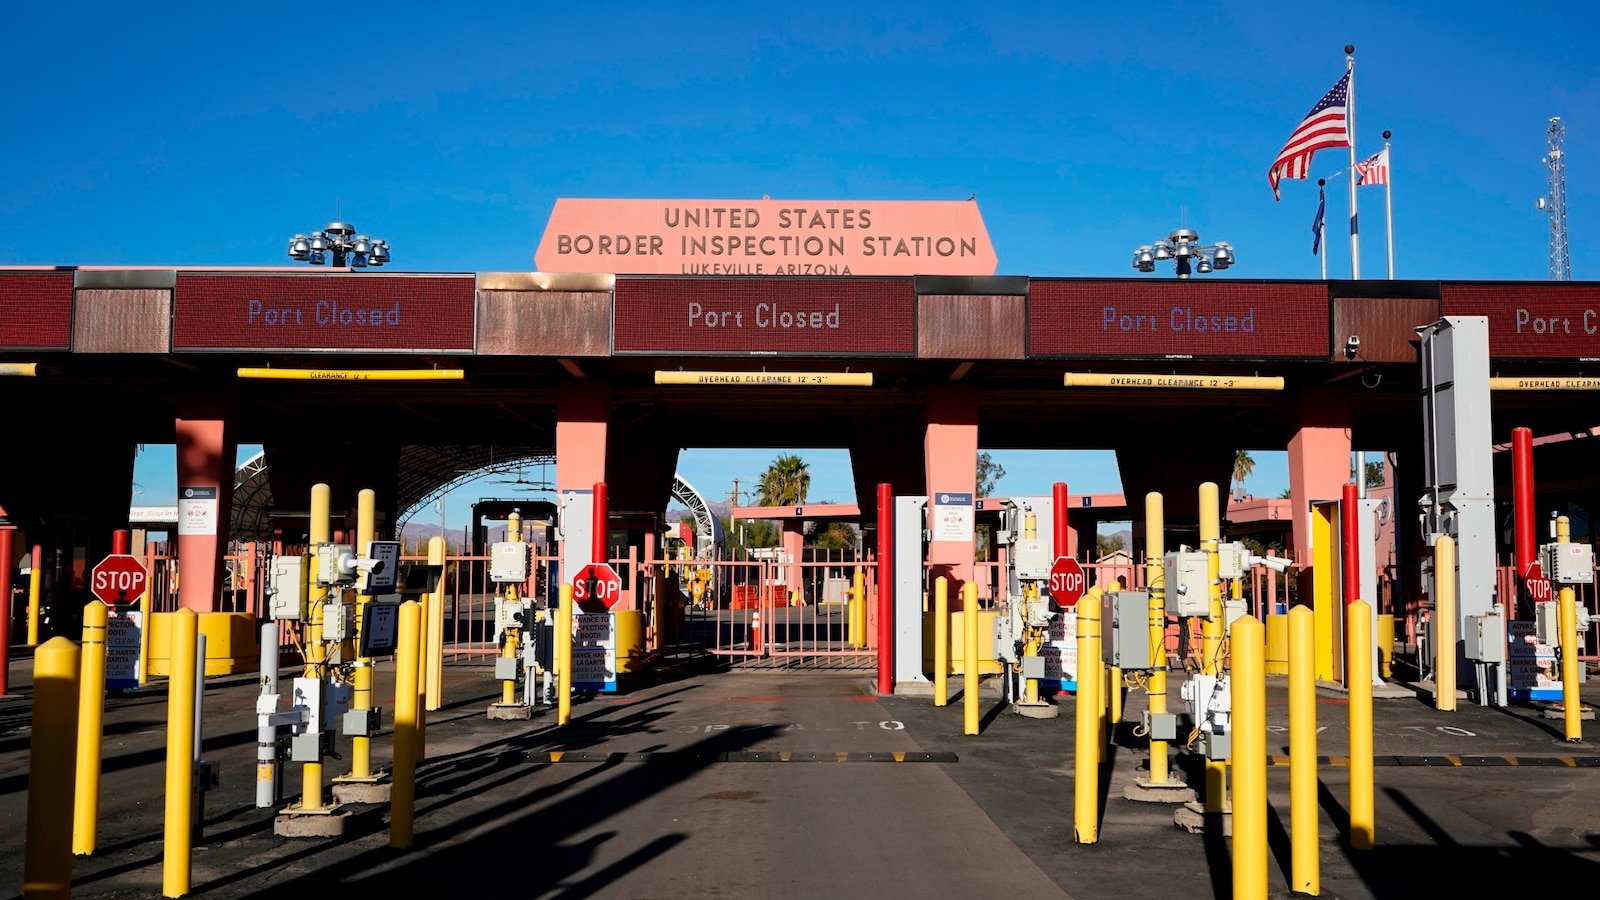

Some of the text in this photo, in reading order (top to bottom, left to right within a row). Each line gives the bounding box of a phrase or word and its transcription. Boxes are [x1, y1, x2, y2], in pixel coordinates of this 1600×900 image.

[664, 207, 872, 229] UNITED STATES
[557, 234, 977, 257] BORDER INSPECTION STATION
[776, 264, 852, 276] ARIZONA
[247, 299, 401, 325] Port Closed
[688, 302, 840, 329] Port Closed
[1103, 305, 1256, 333] Port Closed
[1516, 308, 1571, 334] Port
[745, 376, 792, 384] CLEARANCE
[1110, 377, 1153, 386] OVERHEAD
[1157, 379, 1204, 387] CLEARANCE
[1519, 380, 1600, 388] OVERHEAD CLEARAN
[95, 571, 144, 590] STOP
[574, 579, 618, 599] STOP
[1051, 573, 1082, 592] STOP
[1526, 578, 1550, 599] STOP
